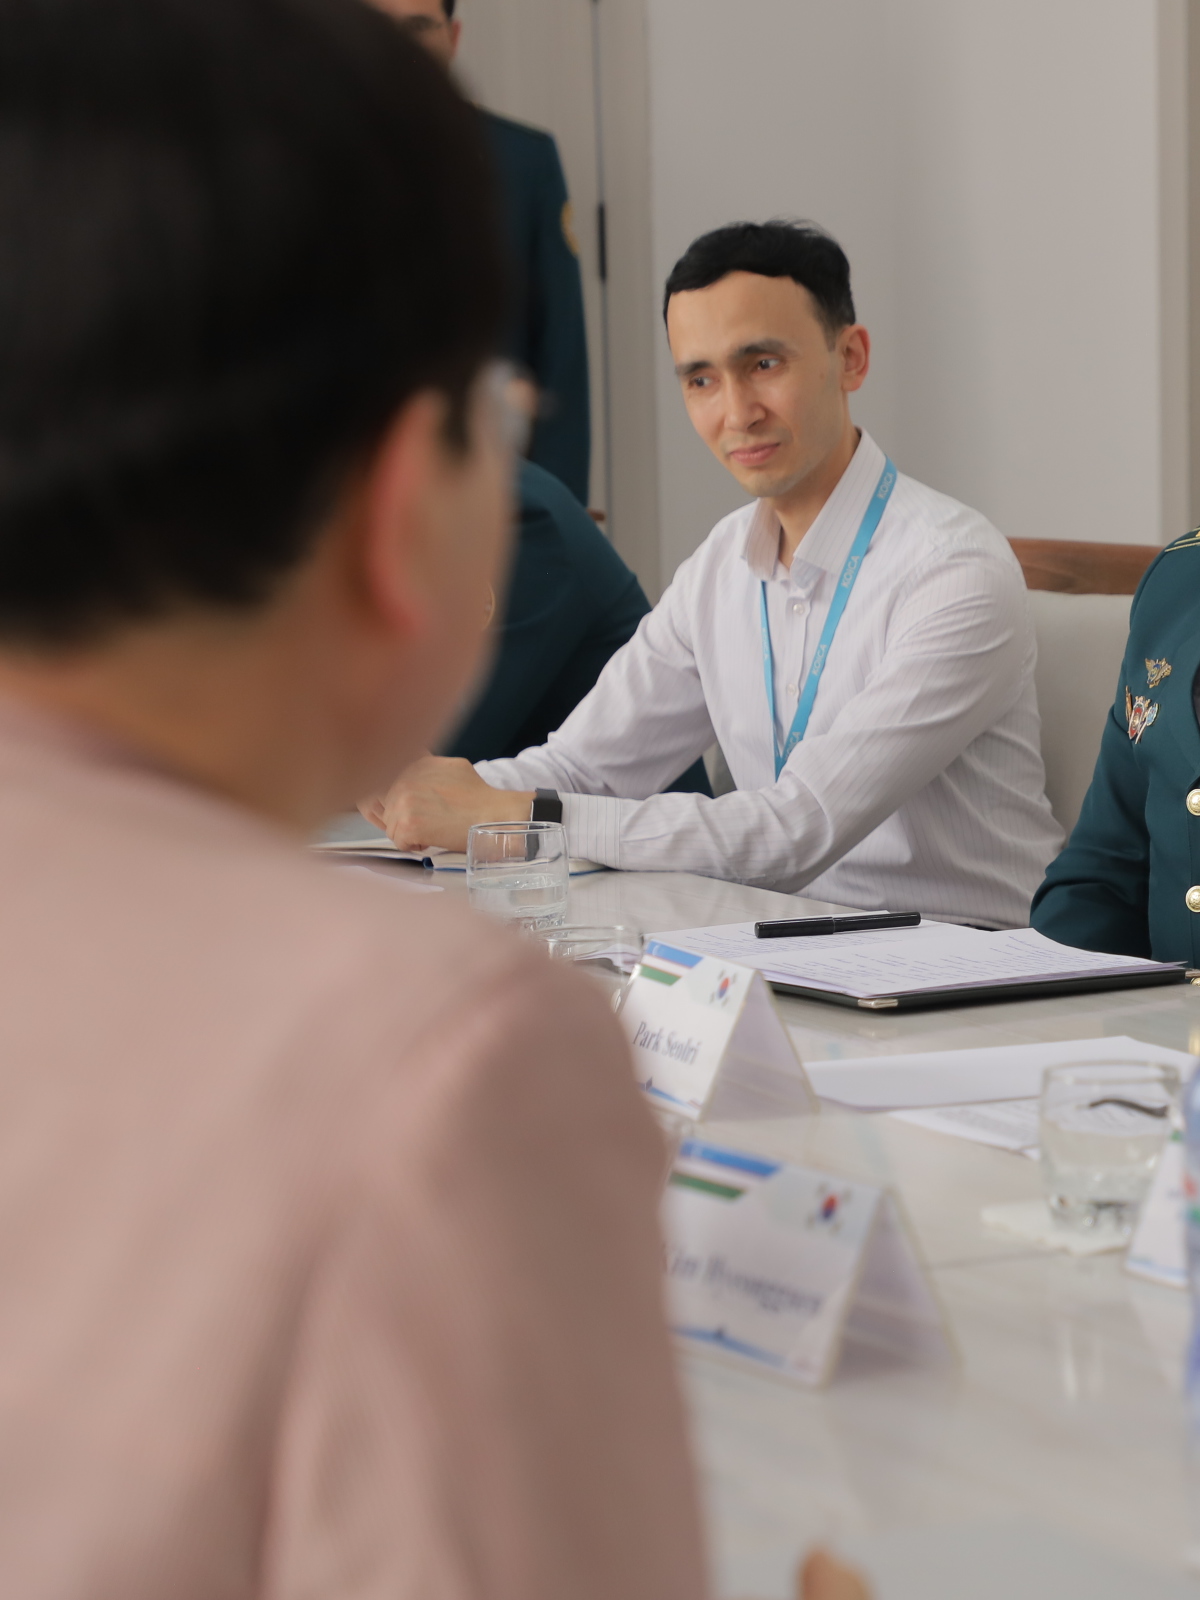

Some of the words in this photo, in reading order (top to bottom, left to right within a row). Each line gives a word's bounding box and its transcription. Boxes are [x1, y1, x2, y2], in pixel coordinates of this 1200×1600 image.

[840, 555, 860, 588] KOICA
[811, 644, 828, 677] KOICA
[632, 1020, 664, 1053] Park
